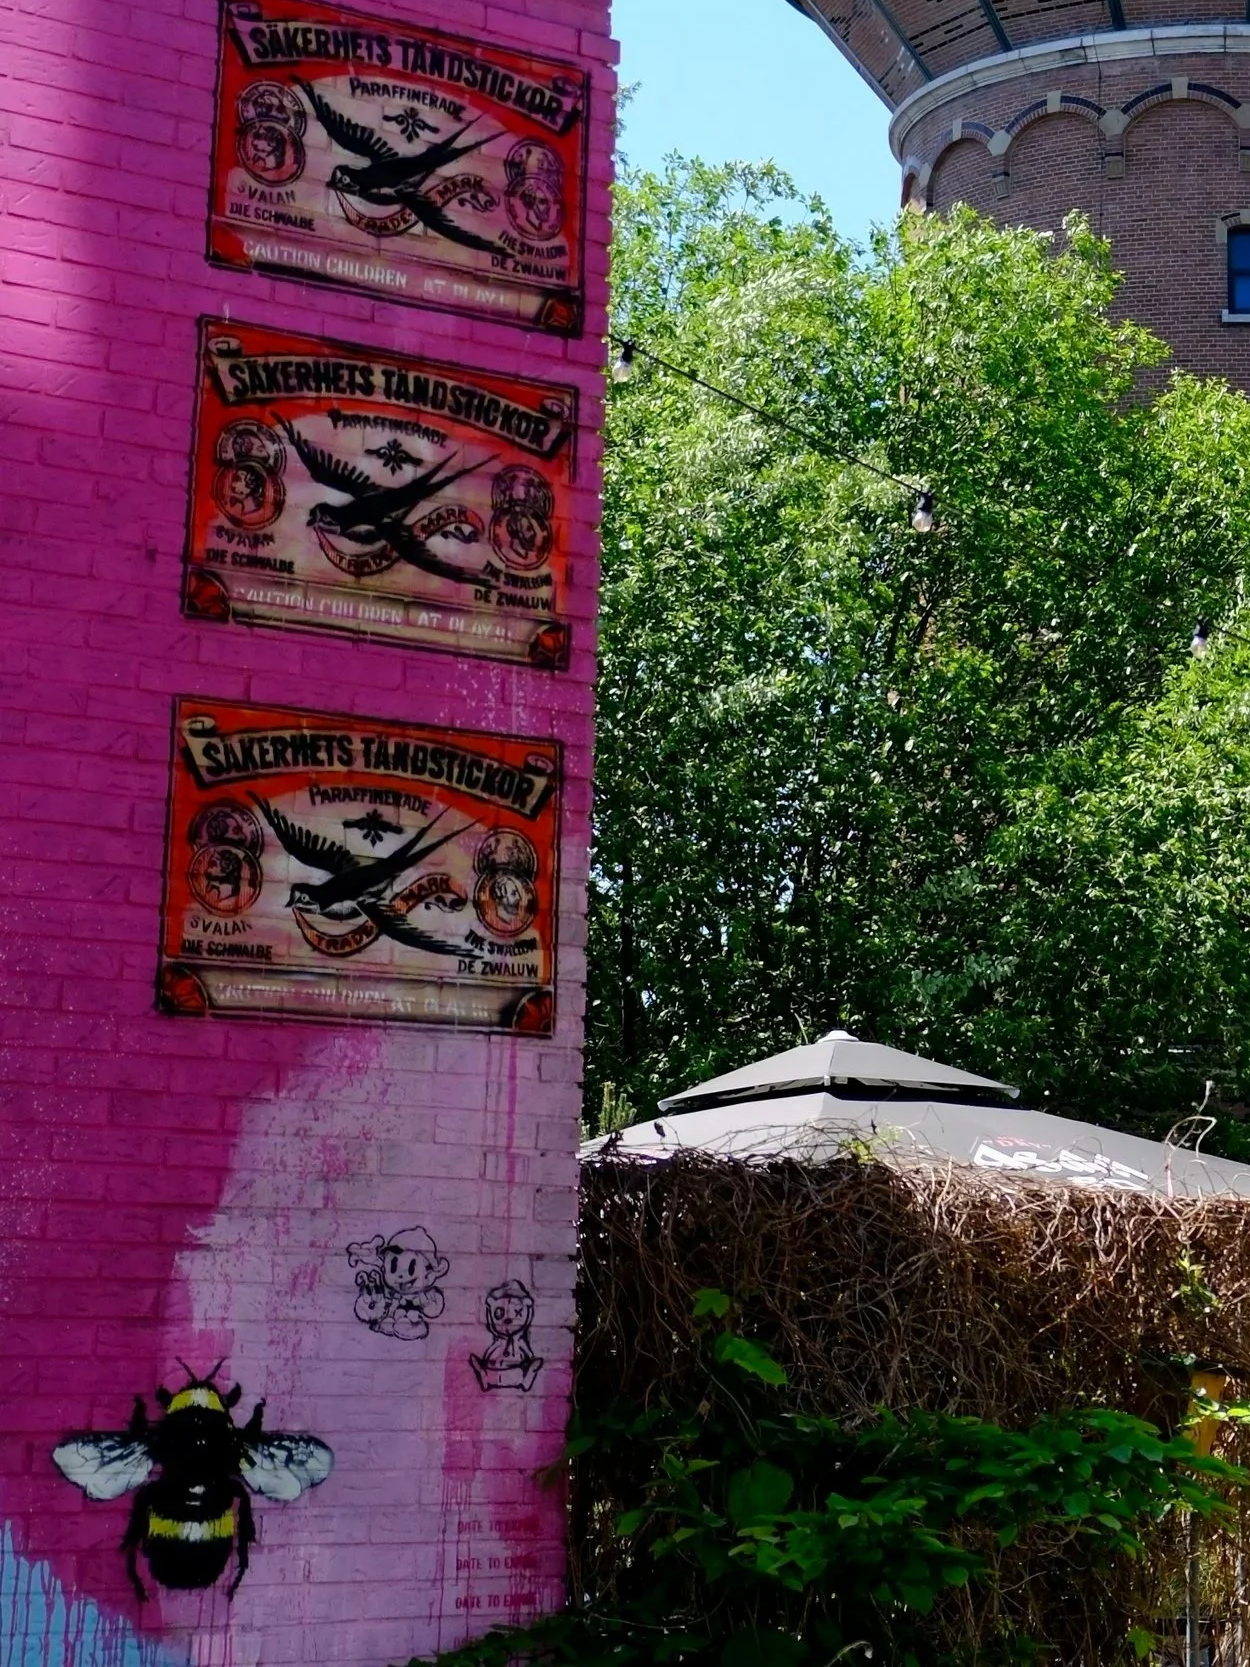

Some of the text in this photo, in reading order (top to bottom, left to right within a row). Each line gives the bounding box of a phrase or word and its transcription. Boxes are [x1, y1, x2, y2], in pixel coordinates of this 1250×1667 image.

[248, 24, 392, 67] SÄKERHETS
[350, 77, 467, 122] PARAFFINERADE
[237, 182, 296, 204] SVALAN
[229, 202, 316, 232] DIE SCHWALBE
[497, 230, 518, 252] THE
[242, 240, 320, 269] CAUTION
[326, 256, 408, 289] CHILDREN
[423, 278, 446, 294] AT
[491, 255, 567, 282] DE ZWALUW
[228, 359, 376, 398] SÄKERHETS
[327, 408, 449, 448] PARAFFINERADE
[421, 508, 469, 533] MARK
[205, 548, 295, 574] DIE SCHWALBE
[232, 588, 314, 611] CAUTION
[319, 599, 402, 628] CHILDREN
[417, 611, 443, 628] AT
[474, 588, 551, 611] DE ZWALUW
[181, 939, 273, 961] DIE SCHWALBE
[458, 959, 539, 977] DE ZWALUW
[391, 995, 417, 1015] AT
[457, 1519, 482, 1534] DATE
[488, 1519, 502, 1533] TO
[456, 1557, 482, 1571] DATE
[488, 1556, 501, 1570] TO
[455, 1594, 481, 1610] DATE
[487, 1594, 501, 1608] TO
